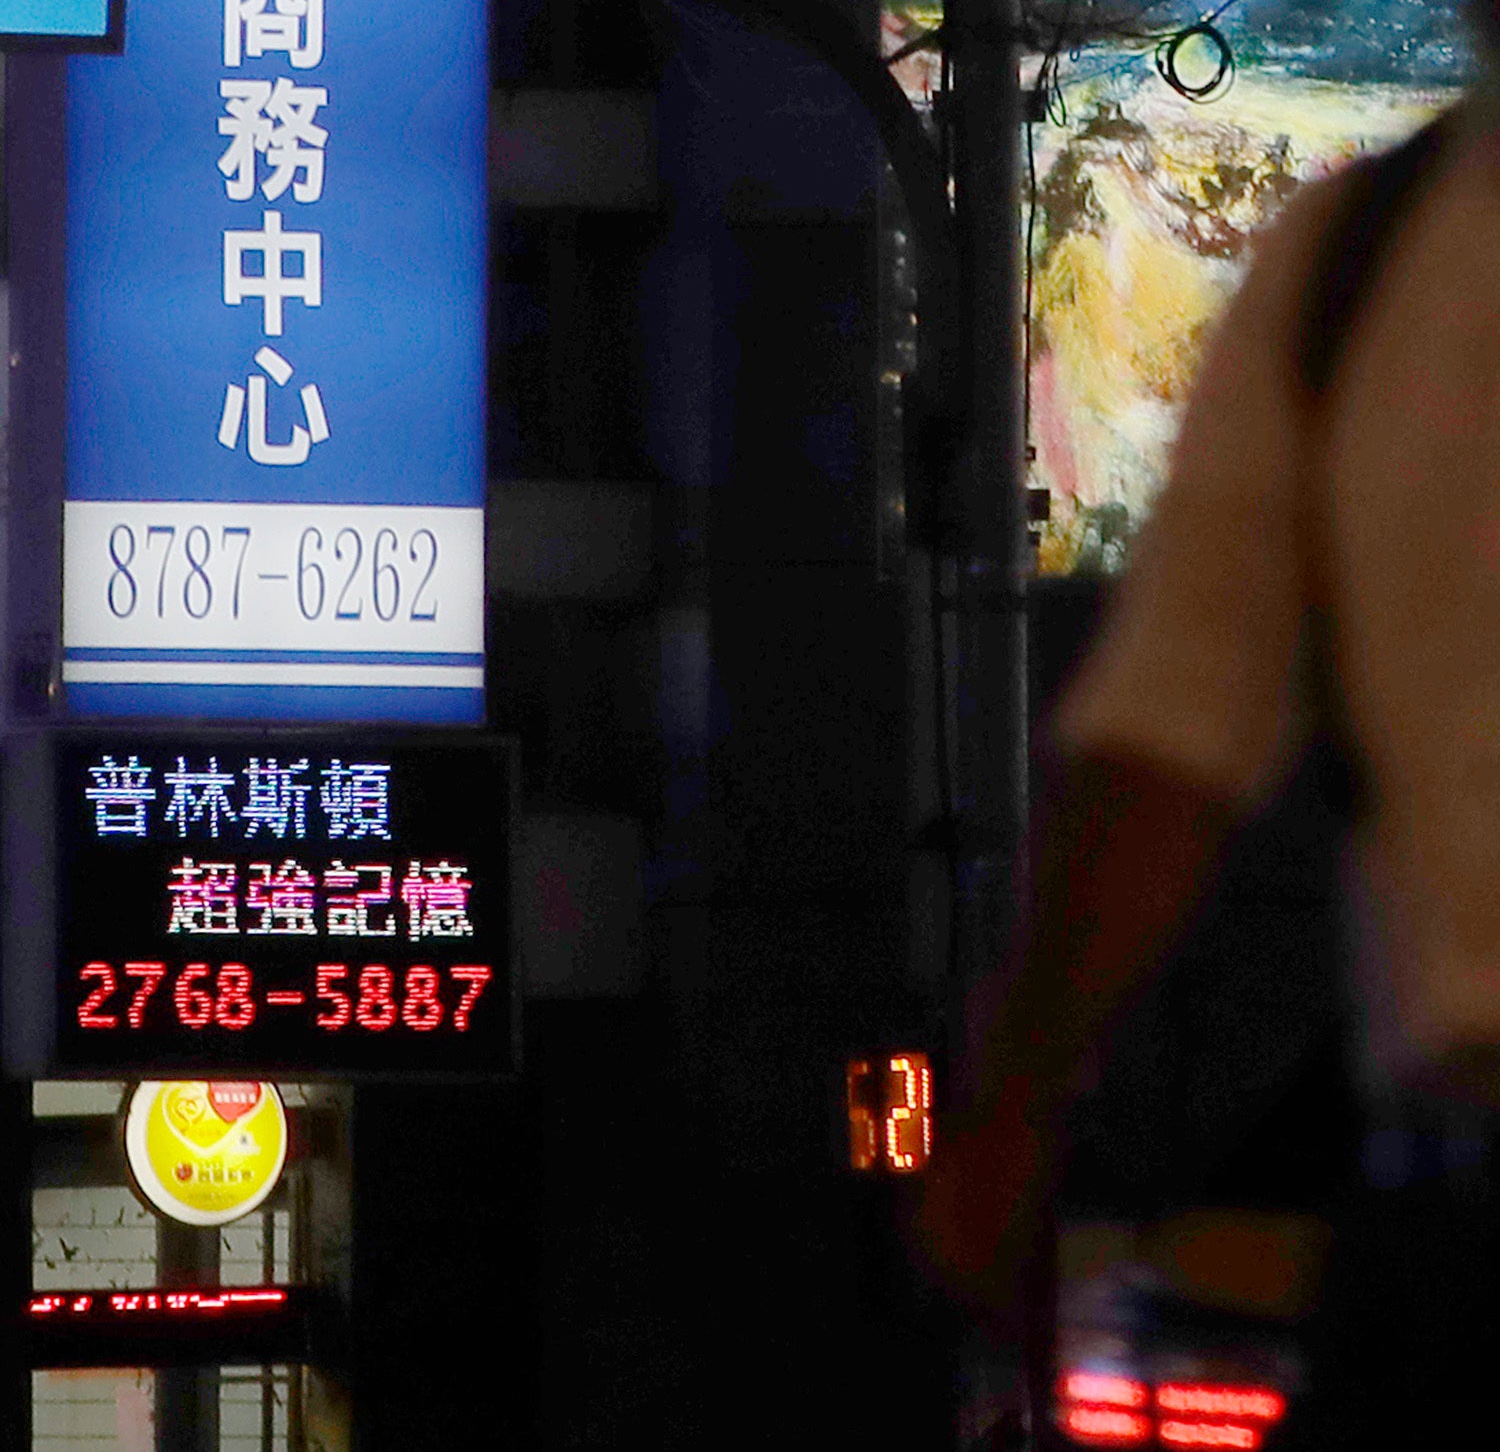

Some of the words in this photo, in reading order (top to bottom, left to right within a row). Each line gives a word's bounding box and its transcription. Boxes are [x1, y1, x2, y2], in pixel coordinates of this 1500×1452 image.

[106, 523, 439, 622] 8787-6262
[85, 756, 392, 840] 普林斯頓
[167, 857, 475, 941] 超強記憶
[78, 962, 492, 1031] 2768-5887
